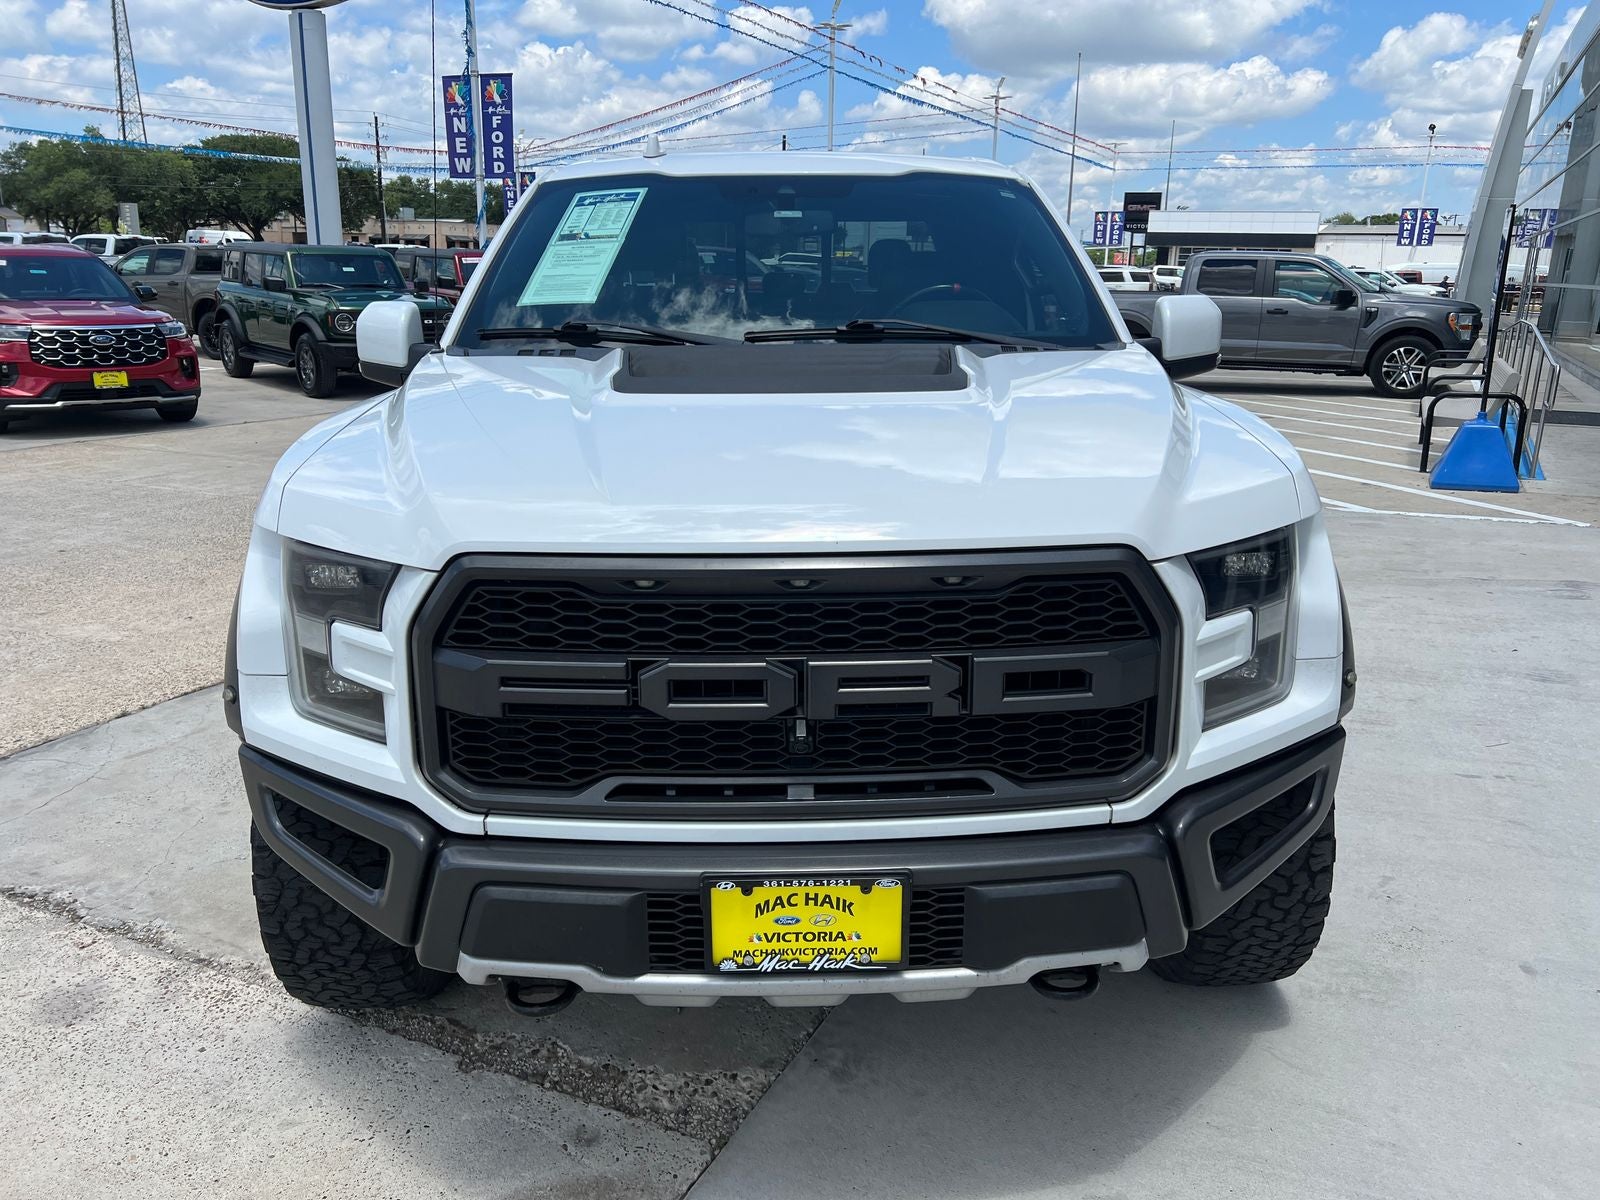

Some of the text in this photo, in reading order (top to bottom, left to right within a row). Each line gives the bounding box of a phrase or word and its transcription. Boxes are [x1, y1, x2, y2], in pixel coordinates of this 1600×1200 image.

[453, 117, 471, 173] NEW
[492, 116, 505, 173] FORD
[506, 191, 514, 214] NE
[1096, 225, 1104, 244] NEW
[1401, 223, 1411, 245] NEW
[1421, 223, 1430, 245] FORD
[434, 648, 1158, 722] FORD
[763, 879, 851, 888] 361-576-1221
[754, 892, 855, 919] MAC HAIK
[777, 916, 798, 925] Ford
[763, 931, 847, 944] VICTORIA
[732, 946, 878, 958] MACHAIKVICTORIA.COM
[756, 953, 866, 972] Mac Haik
